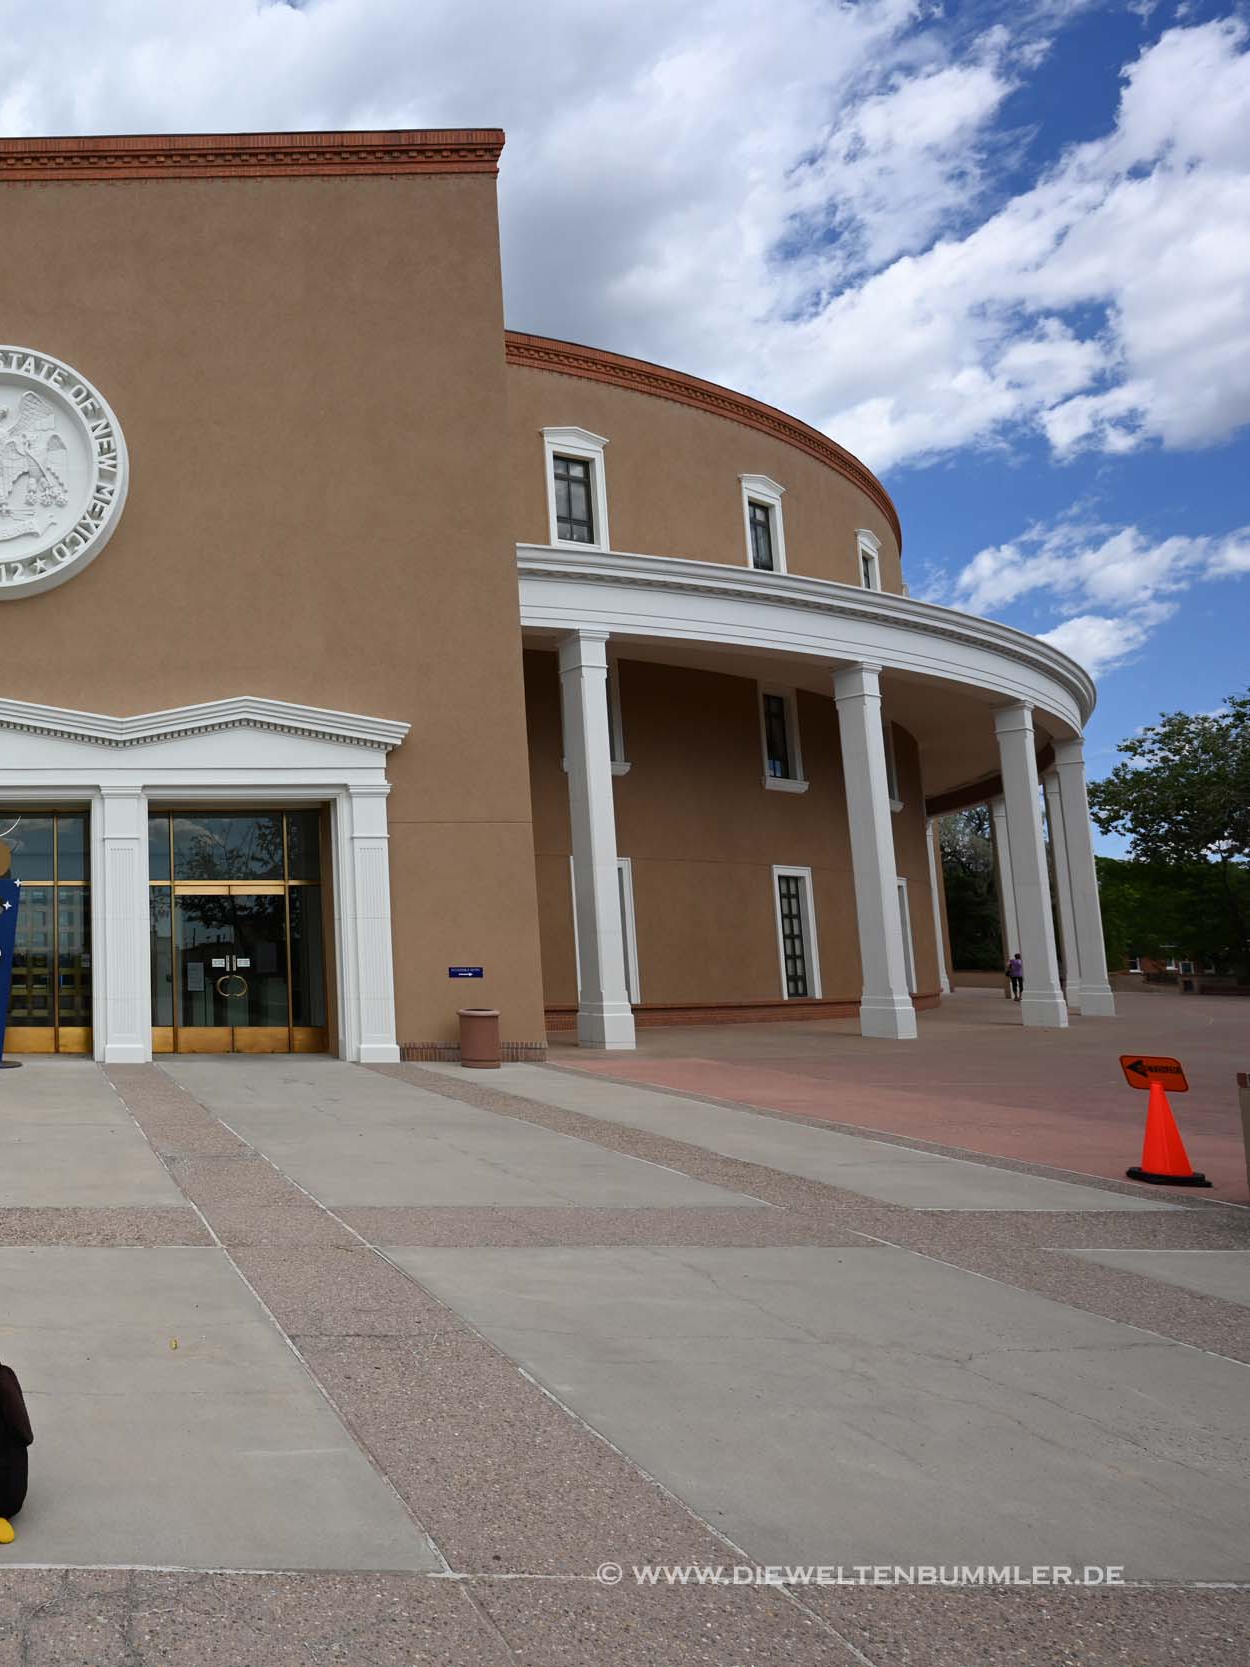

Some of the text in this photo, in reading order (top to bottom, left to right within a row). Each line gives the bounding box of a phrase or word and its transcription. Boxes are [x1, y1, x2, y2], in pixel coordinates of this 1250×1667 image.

[68, 384, 99, 417] OF
[91, 418, 118, 472] NEW
[52, 482, 116, 562] MEXICO
